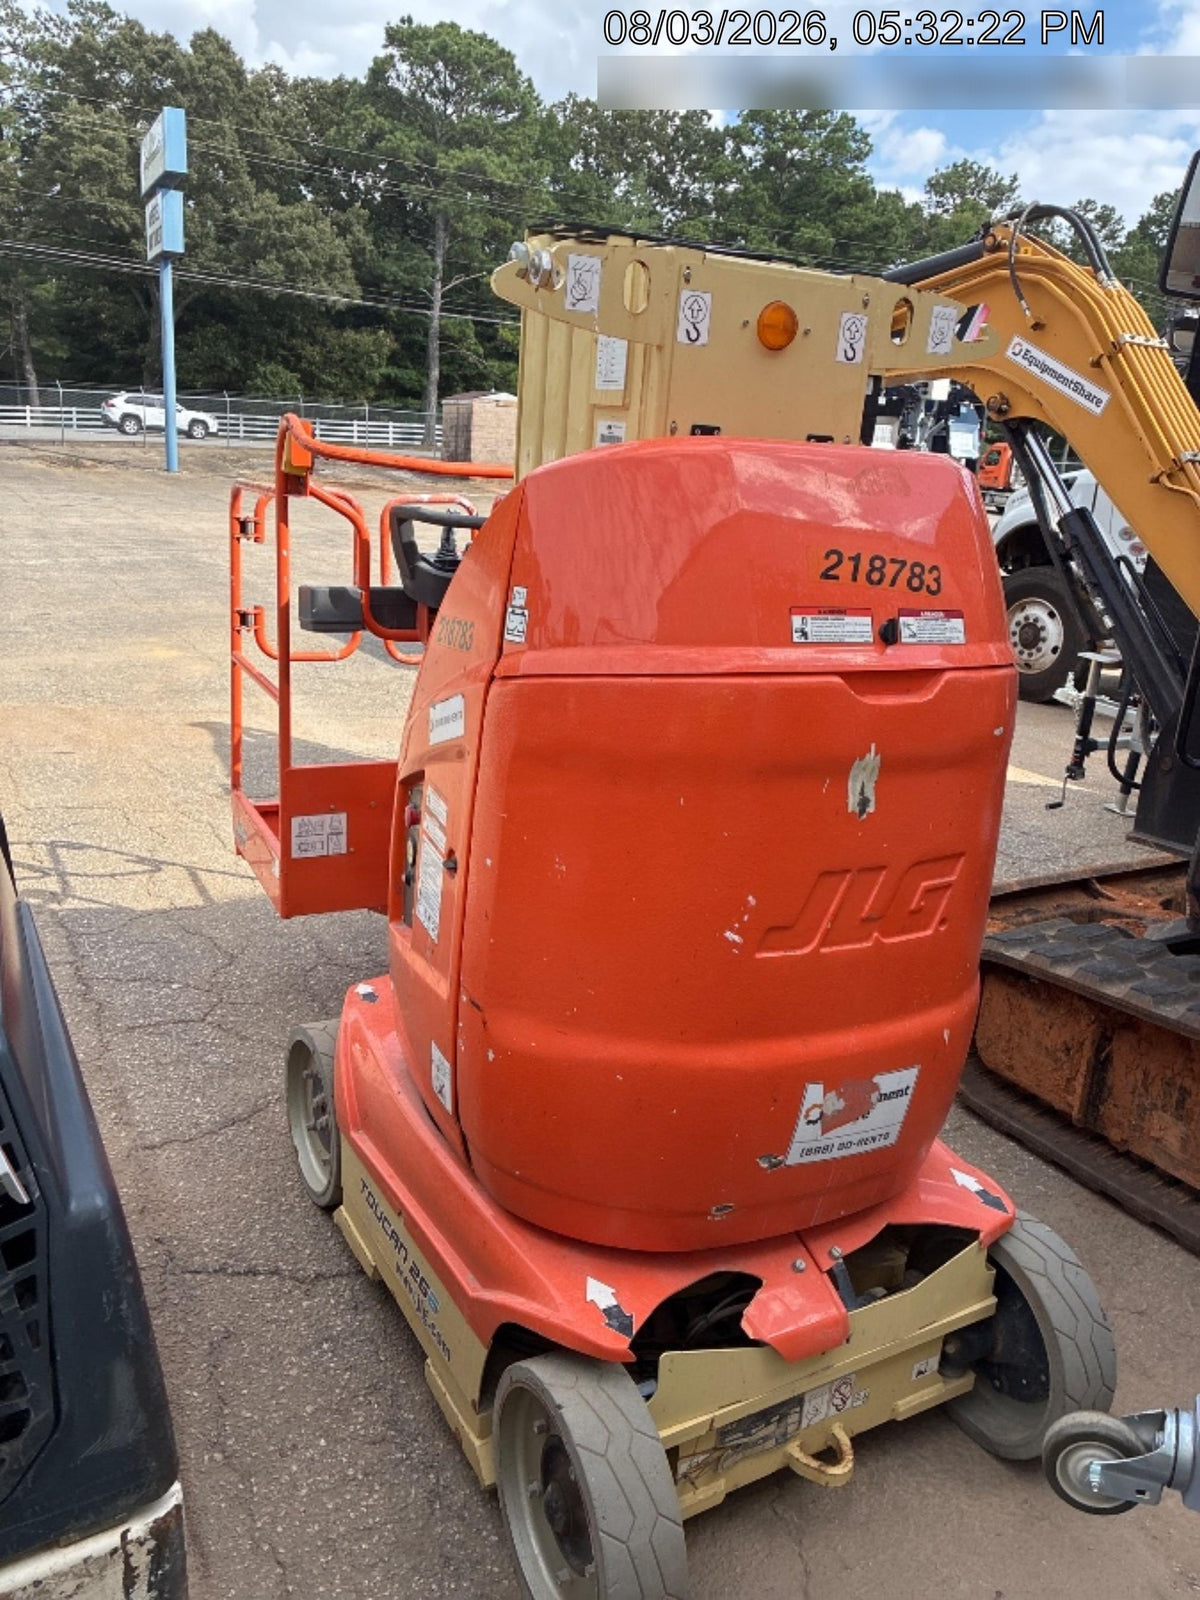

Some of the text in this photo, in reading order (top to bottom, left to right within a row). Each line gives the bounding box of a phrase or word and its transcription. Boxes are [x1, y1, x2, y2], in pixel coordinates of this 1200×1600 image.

[1022, 348, 1104, 408] EquipmentShare
[820, 548, 942, 596] 218783
[360, 1177, 409, 1265] TOUCAN
